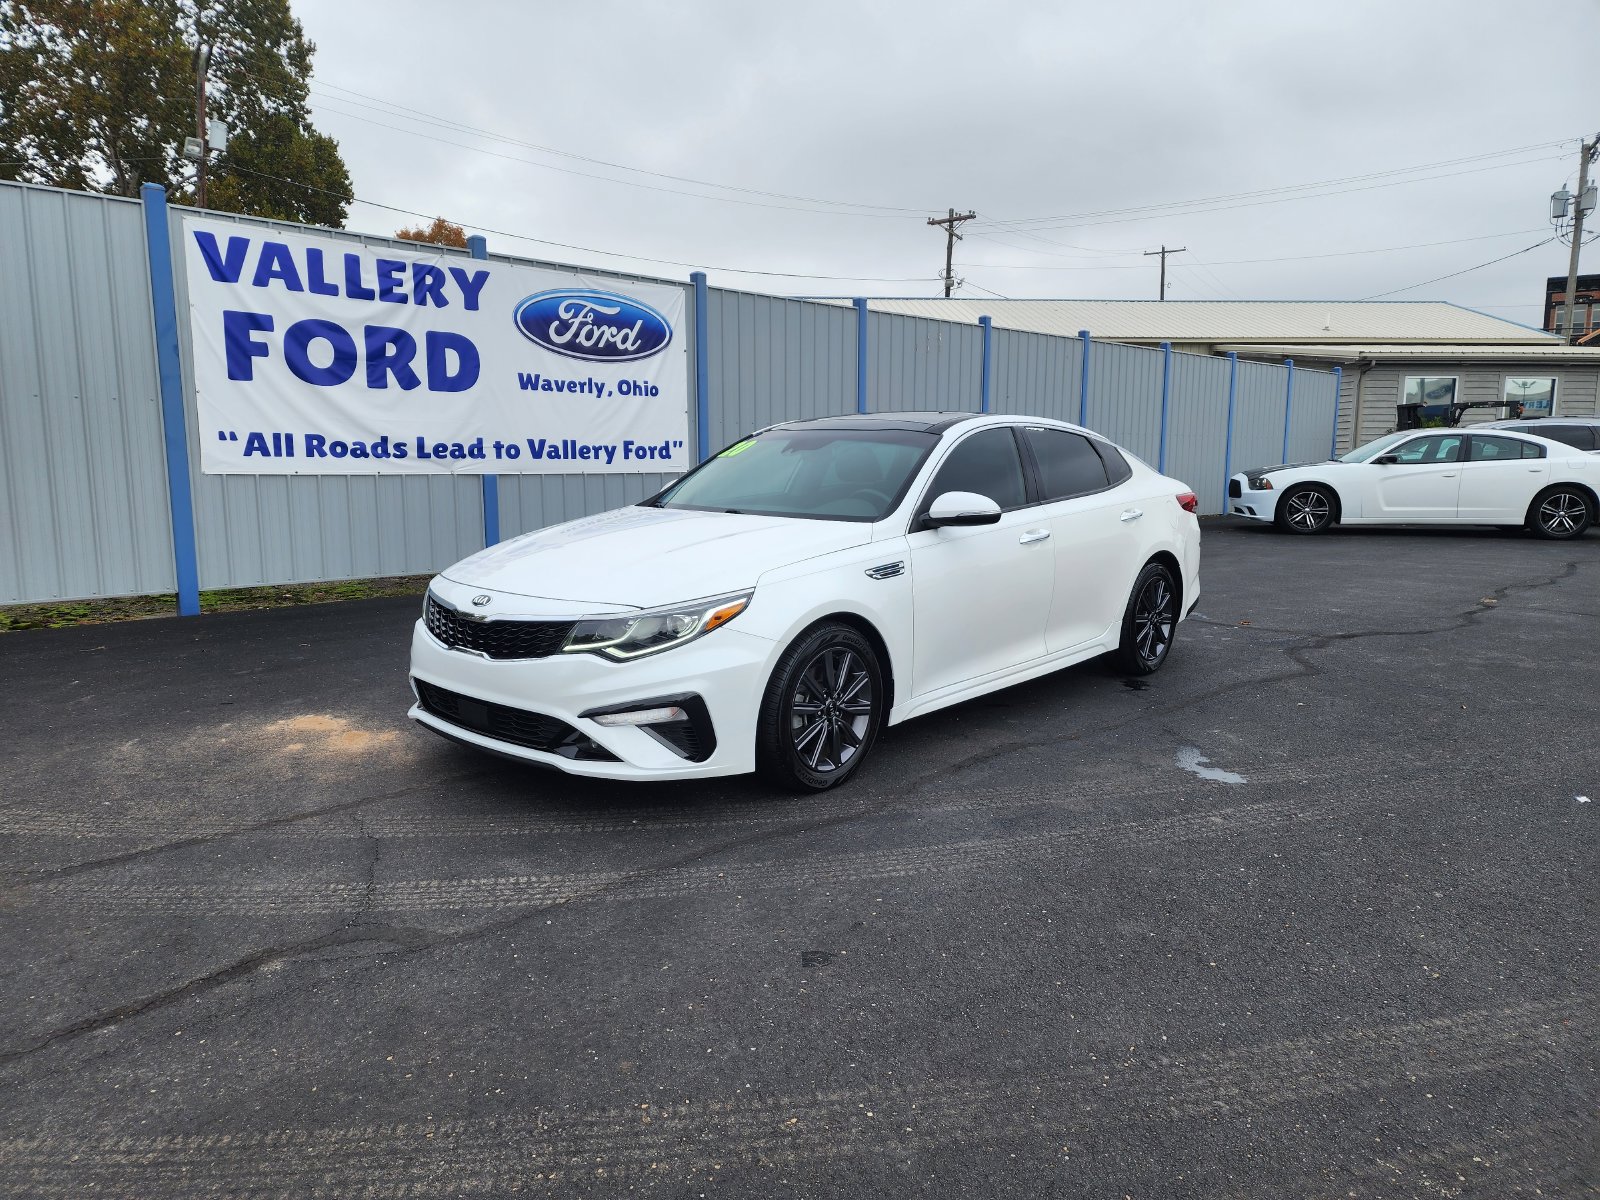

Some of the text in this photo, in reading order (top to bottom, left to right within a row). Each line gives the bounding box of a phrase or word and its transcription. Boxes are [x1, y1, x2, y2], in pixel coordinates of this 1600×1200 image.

[193, 230, 491, 312] VALLERY
[549, 299, 643, 351] Ford
[222, 310, 481, 393] FORD
[517, 372, 659, 399] Waverly, Ohio
[304, 433, 408, 459] Roads
[416, 436, 487, 460] Lead
[492, 440, 521, 460] to
[526, 438, 617, 465] Vallery
